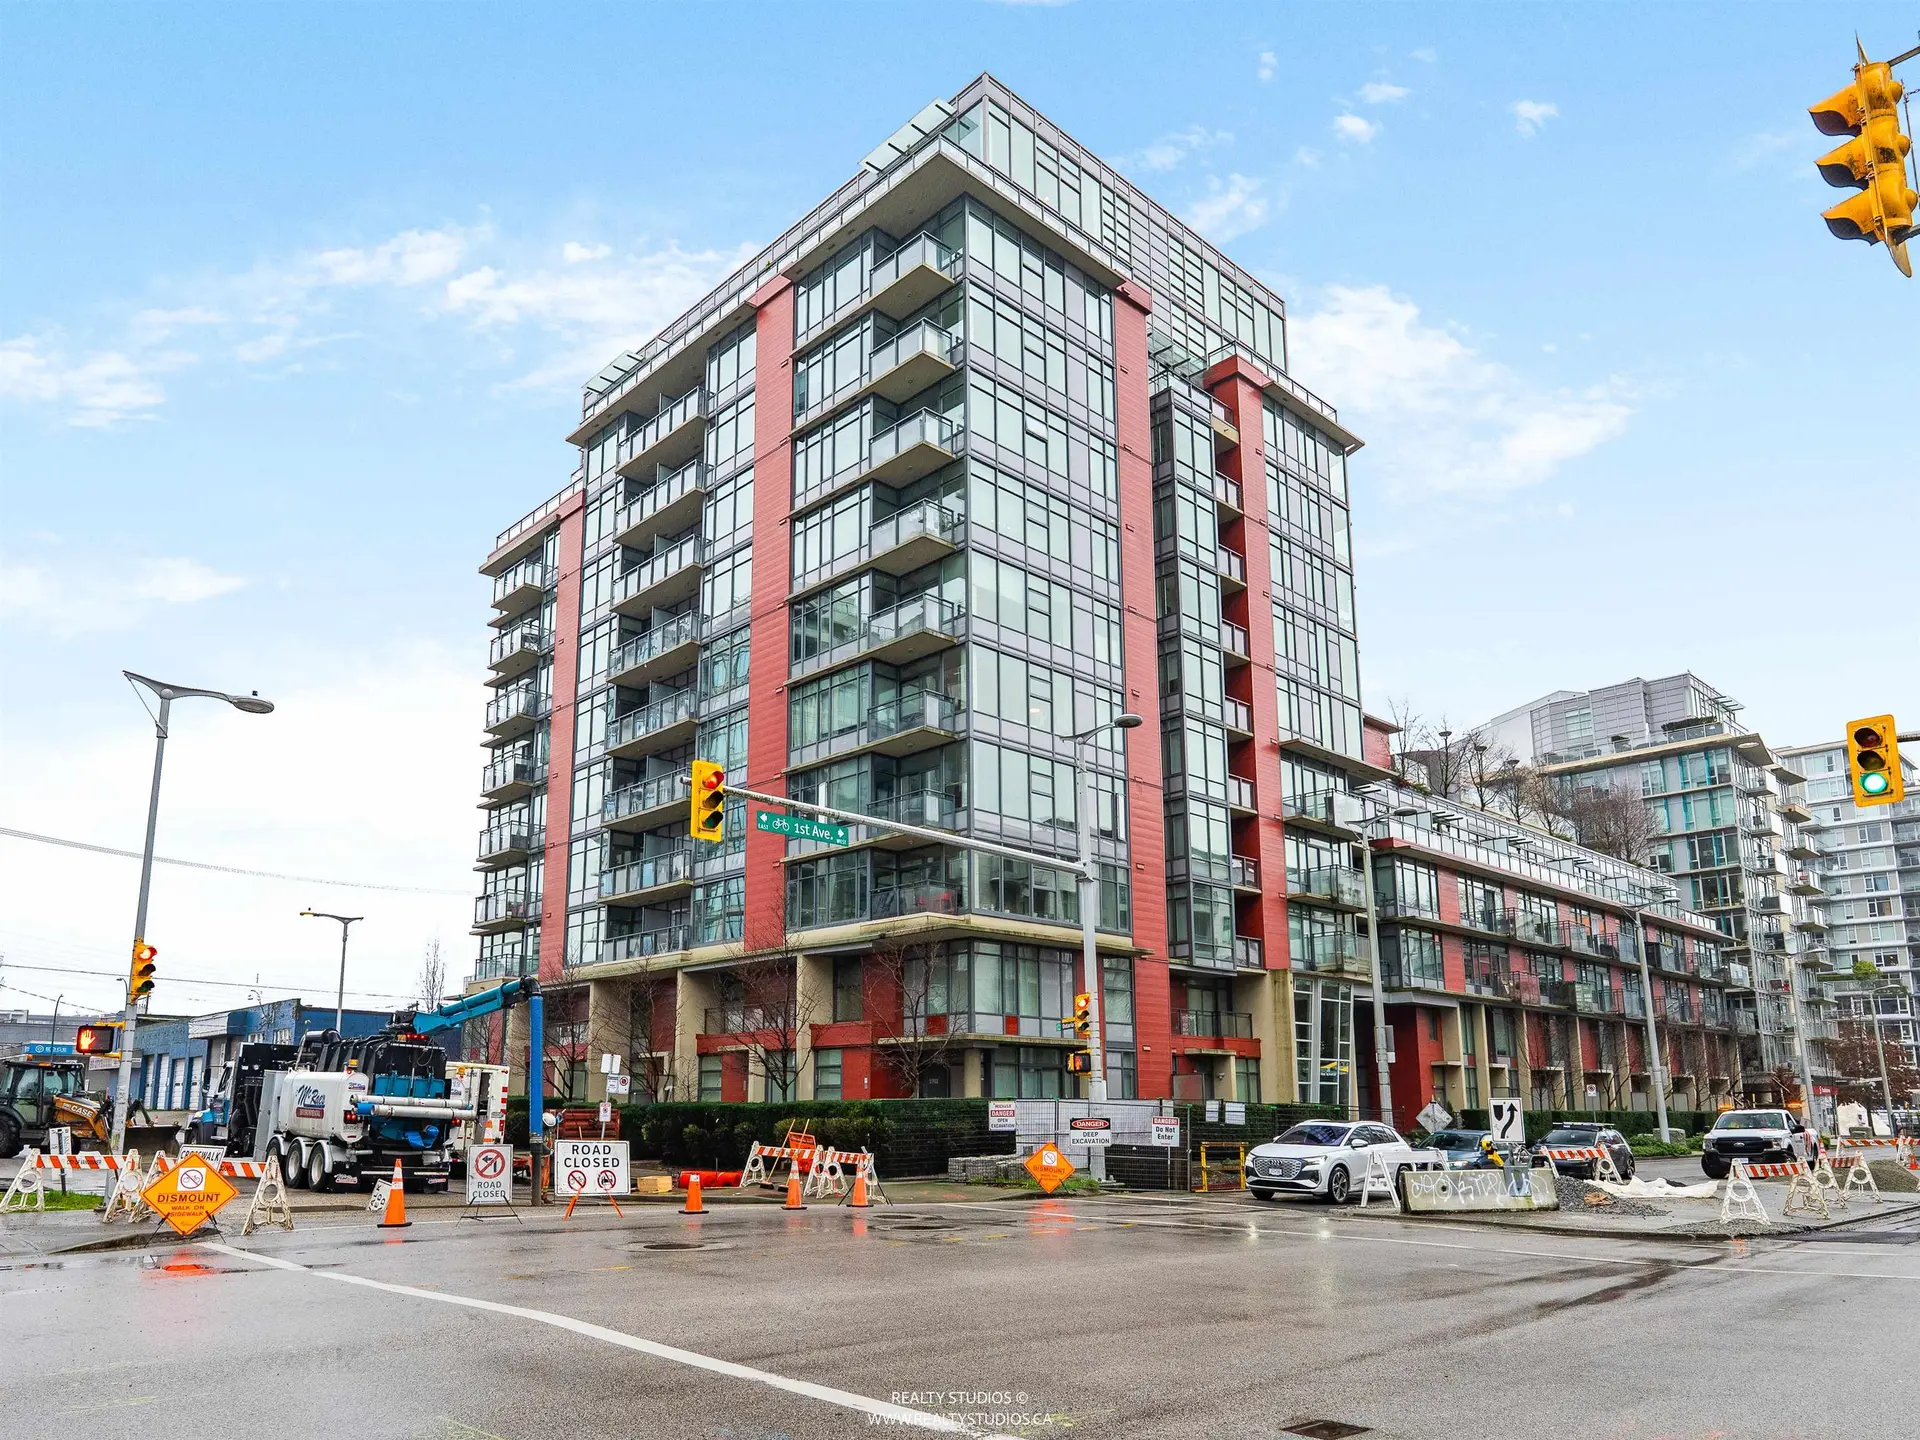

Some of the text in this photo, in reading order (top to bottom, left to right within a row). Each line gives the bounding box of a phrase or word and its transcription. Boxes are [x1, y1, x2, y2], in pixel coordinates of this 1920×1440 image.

[794, 823, 834, 840] 1st Ave.
[71, 1105, 94, 1117] CASE
[1157, 1133, 1174, 1141] Enter
[571, 1144, 612, 1155] ROAD
[181, 1150, 221, 1162] CRWALK
[563, 1157, 620, 1168] CLOSED
[1033, 1165, 1066, 1174] DISMOUNT
[477, 1181, 502, 1189] ROAD
[157, 1193, 221, 1203] DISMOUNT
[472, 1190, 506, 1198] CLOSED
